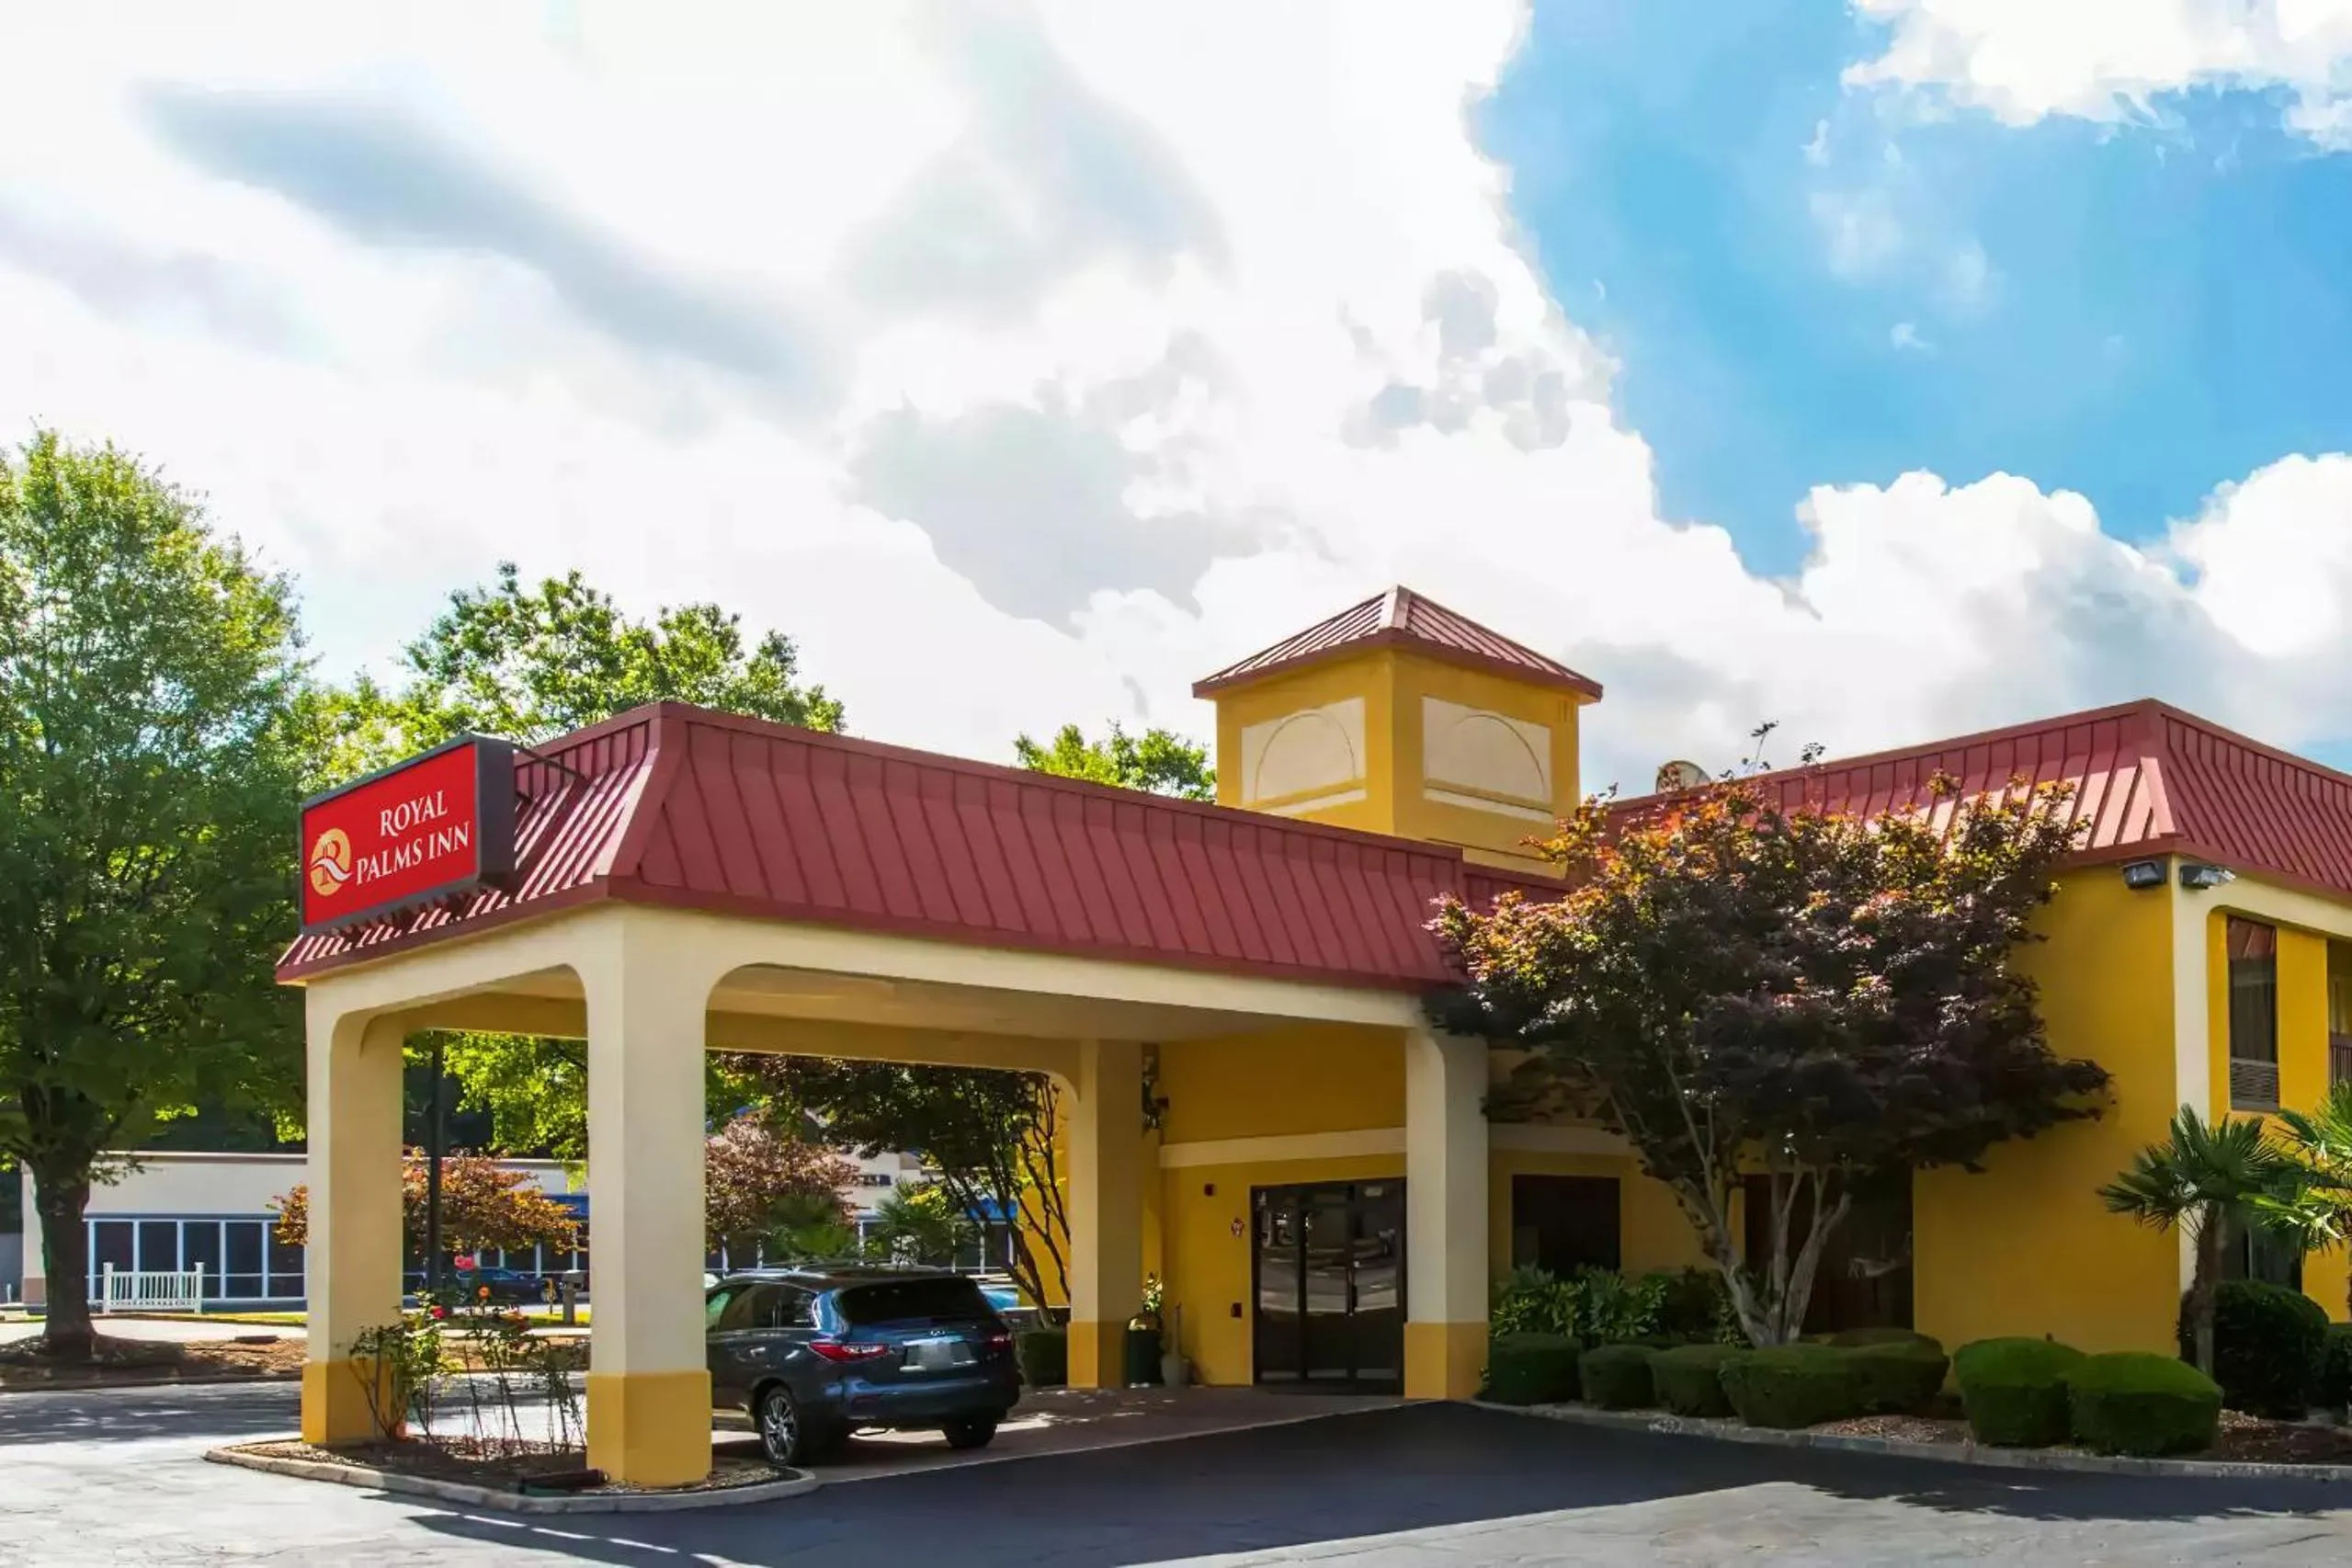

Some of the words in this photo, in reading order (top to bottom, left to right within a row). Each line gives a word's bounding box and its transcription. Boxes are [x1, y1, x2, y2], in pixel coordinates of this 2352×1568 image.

[381, 790, 448, 837] ROYAL
[356, 838, 423, 885] PALMS
[428, 821, 470, 860] INN
